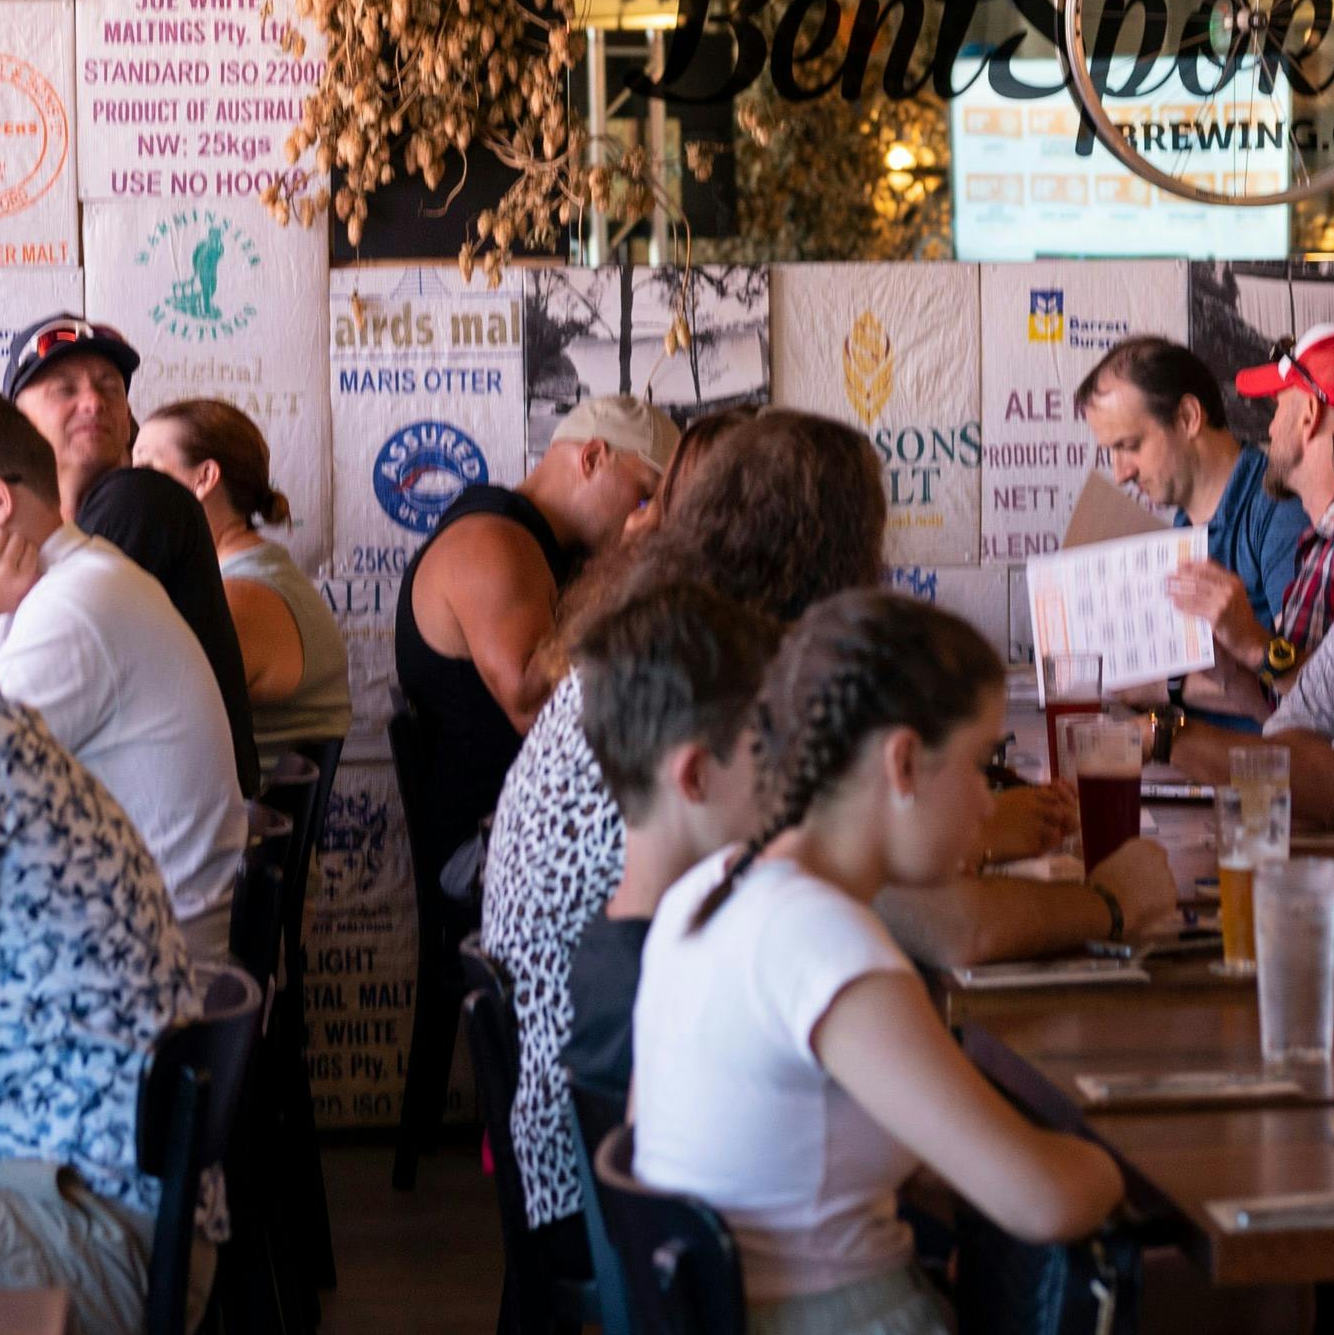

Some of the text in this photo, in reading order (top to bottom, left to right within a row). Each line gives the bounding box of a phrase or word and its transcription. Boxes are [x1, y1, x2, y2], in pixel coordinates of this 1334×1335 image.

[103, 21, 252, 48] MALTINGS Pty.
[84, 59, 209, 85] STANDARD
[220, 61, 259, 84] ISO
[137, 132, 271, 161] NW: 25kgs
[110, 170, 162, 197] USE
[170, 170, 207, 196] NO
[22, 243, 68, 265] MALT
[339, 369, 502, 394] MARIS OTTER
[1005, 390, 1062, 421] ALE
[380, 424, 482, 479] ASSURED
[982, 443, 1088, 468] PRODUCT OF
[993, 485, 1060, 512] NETT
[359, 981, 414, 1010] MALT
[325, 1020, 396, 1044] WHITE
